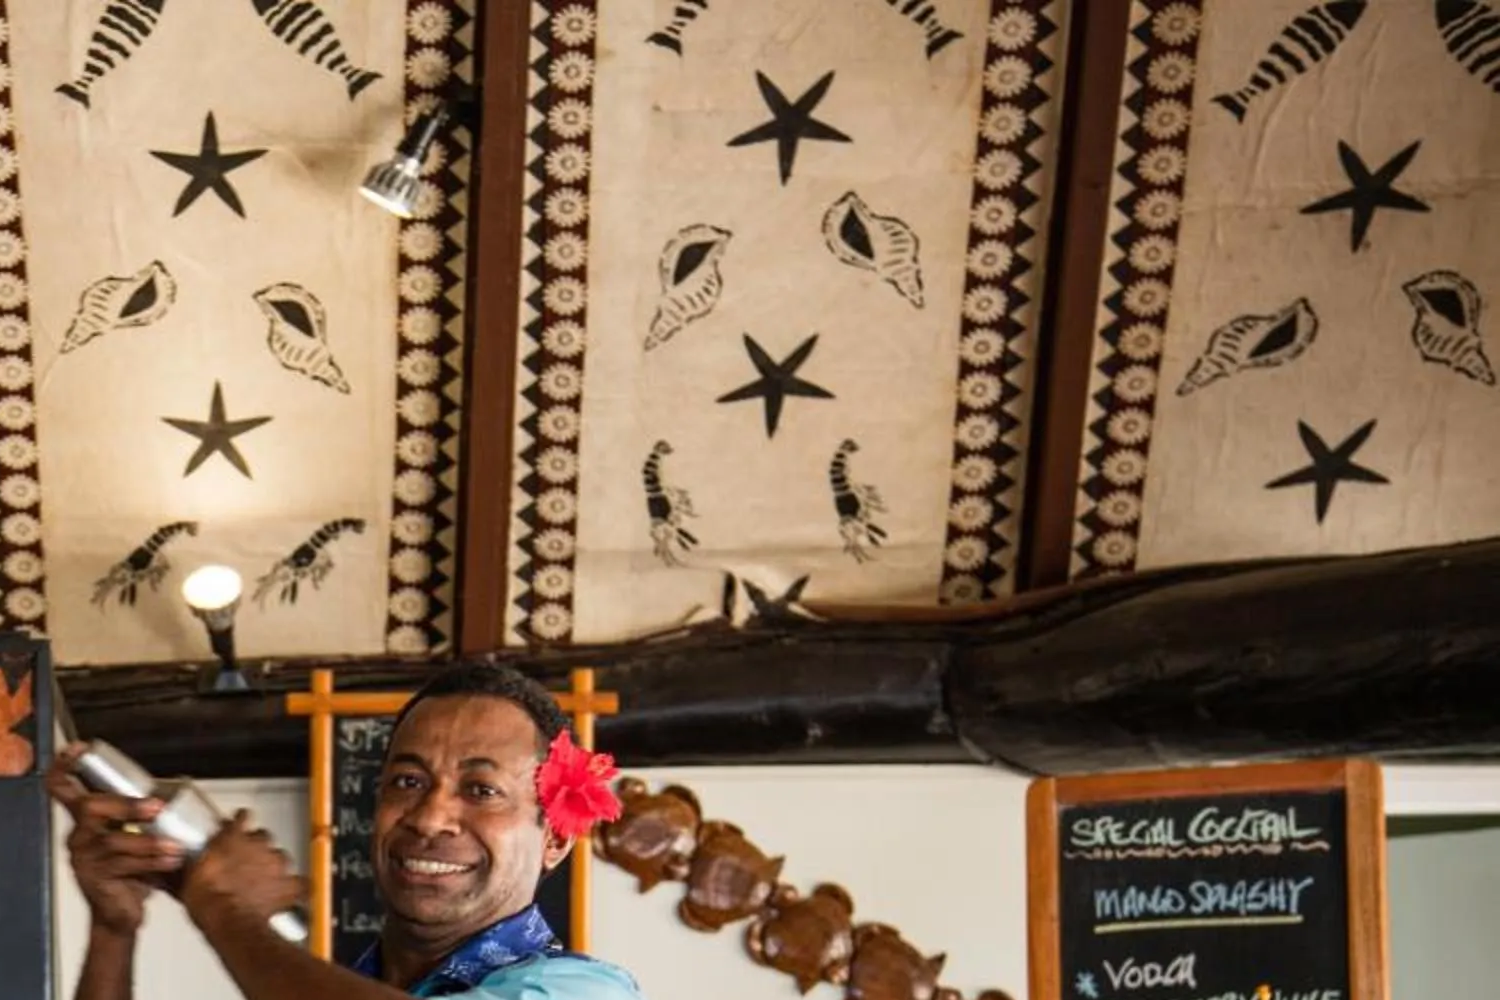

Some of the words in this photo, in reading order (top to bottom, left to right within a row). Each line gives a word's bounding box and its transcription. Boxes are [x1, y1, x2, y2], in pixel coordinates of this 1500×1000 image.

[1070, 815, 1185, 847] SPECIAL
[1187, 807, 1323, 843] COCKTAIL
[1093, 884, 1186, 919] MANGO
